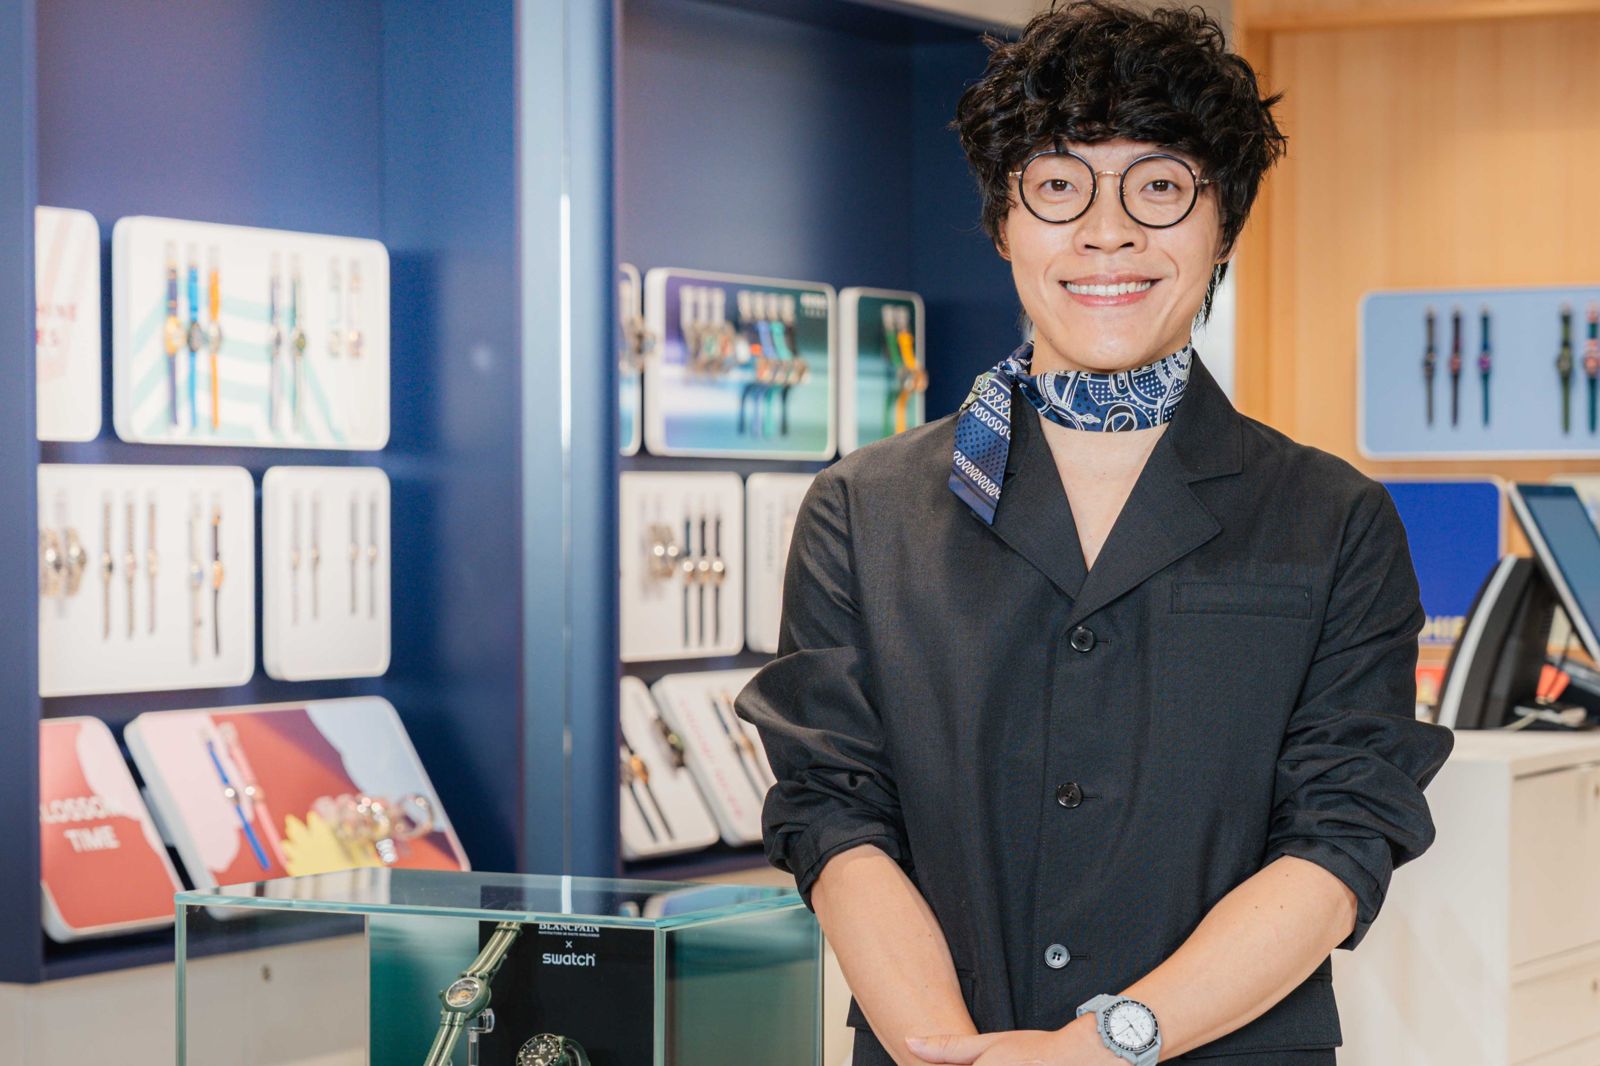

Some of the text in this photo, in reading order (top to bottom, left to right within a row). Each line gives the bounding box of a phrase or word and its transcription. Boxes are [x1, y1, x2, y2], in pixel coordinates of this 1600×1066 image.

[63, 825, 120, 853] TIME
[538, 922, 600, 932] BLANCPAIN
[542, 952, 596, 966] swatch
